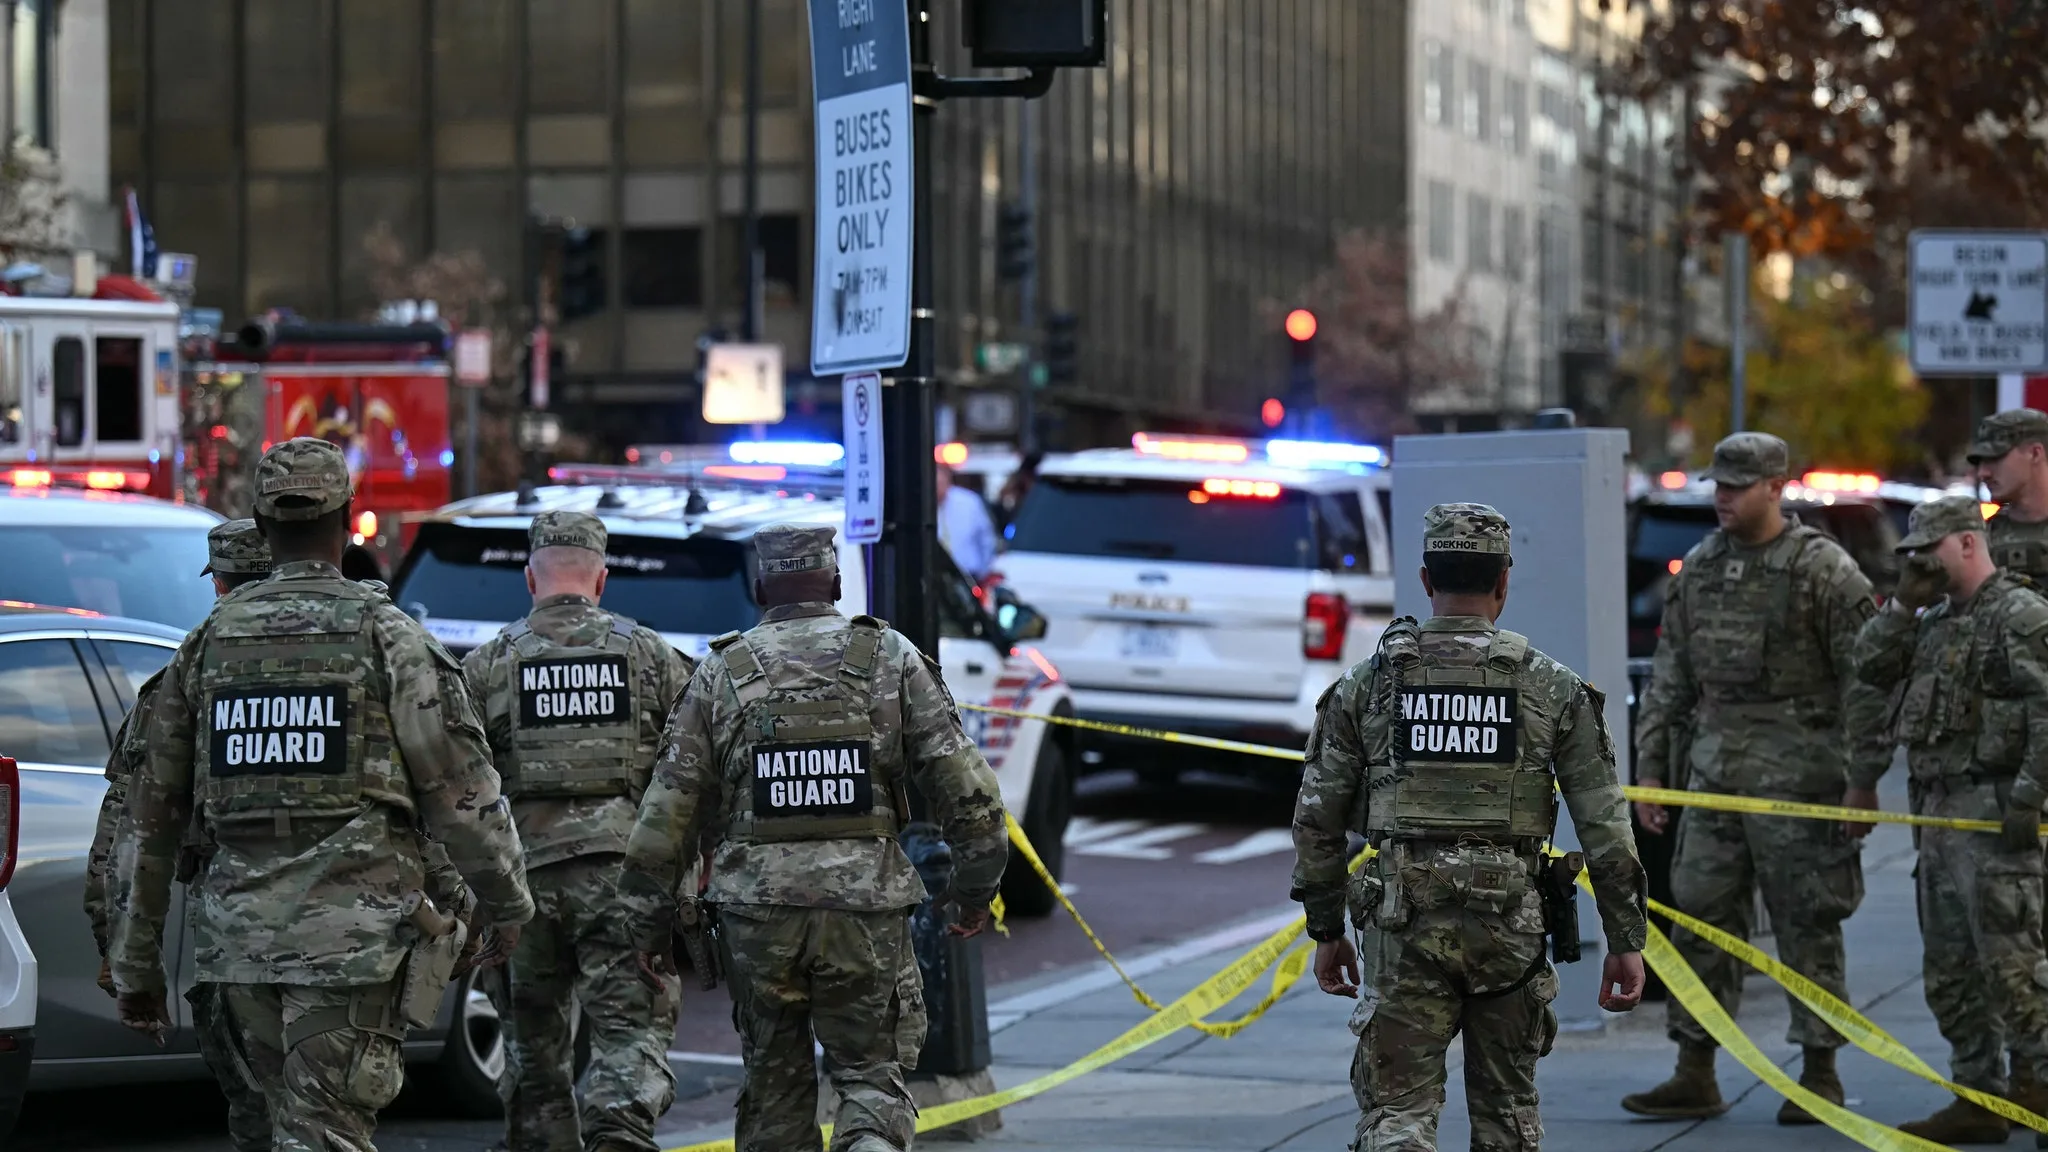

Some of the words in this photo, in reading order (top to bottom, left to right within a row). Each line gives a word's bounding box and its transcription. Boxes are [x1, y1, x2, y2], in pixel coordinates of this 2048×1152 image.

[837, 0, 875, 29] RIGHT
[842, 40, 878, 77] LANE
[835, 108, 892, 157] BUSES
[836, 160, 892, 208] BIKES
[837, 208, 890, 254] ONLY
[264, 475, 321, 492] MIDDLETON
[543, 533, 588, 546] BLANCHARD
[1432, 540, 1478, 550] SOEKHOE
[780, 558, 806, 571] SMITH
[523, 663, 625, 691] NATIONAL
[215, 695, 341, 731] NATIONAL
[536, 690, 615, 718] GUARD
[1400, 693, 1512, 723] NATIONAL
[226, 732, 326, 766] GUARD
[1410, 724, 1499, 754] GUARD
[757, 748, 866, 779] NATIONAL
[770, 778, 856, 808] GUARD
